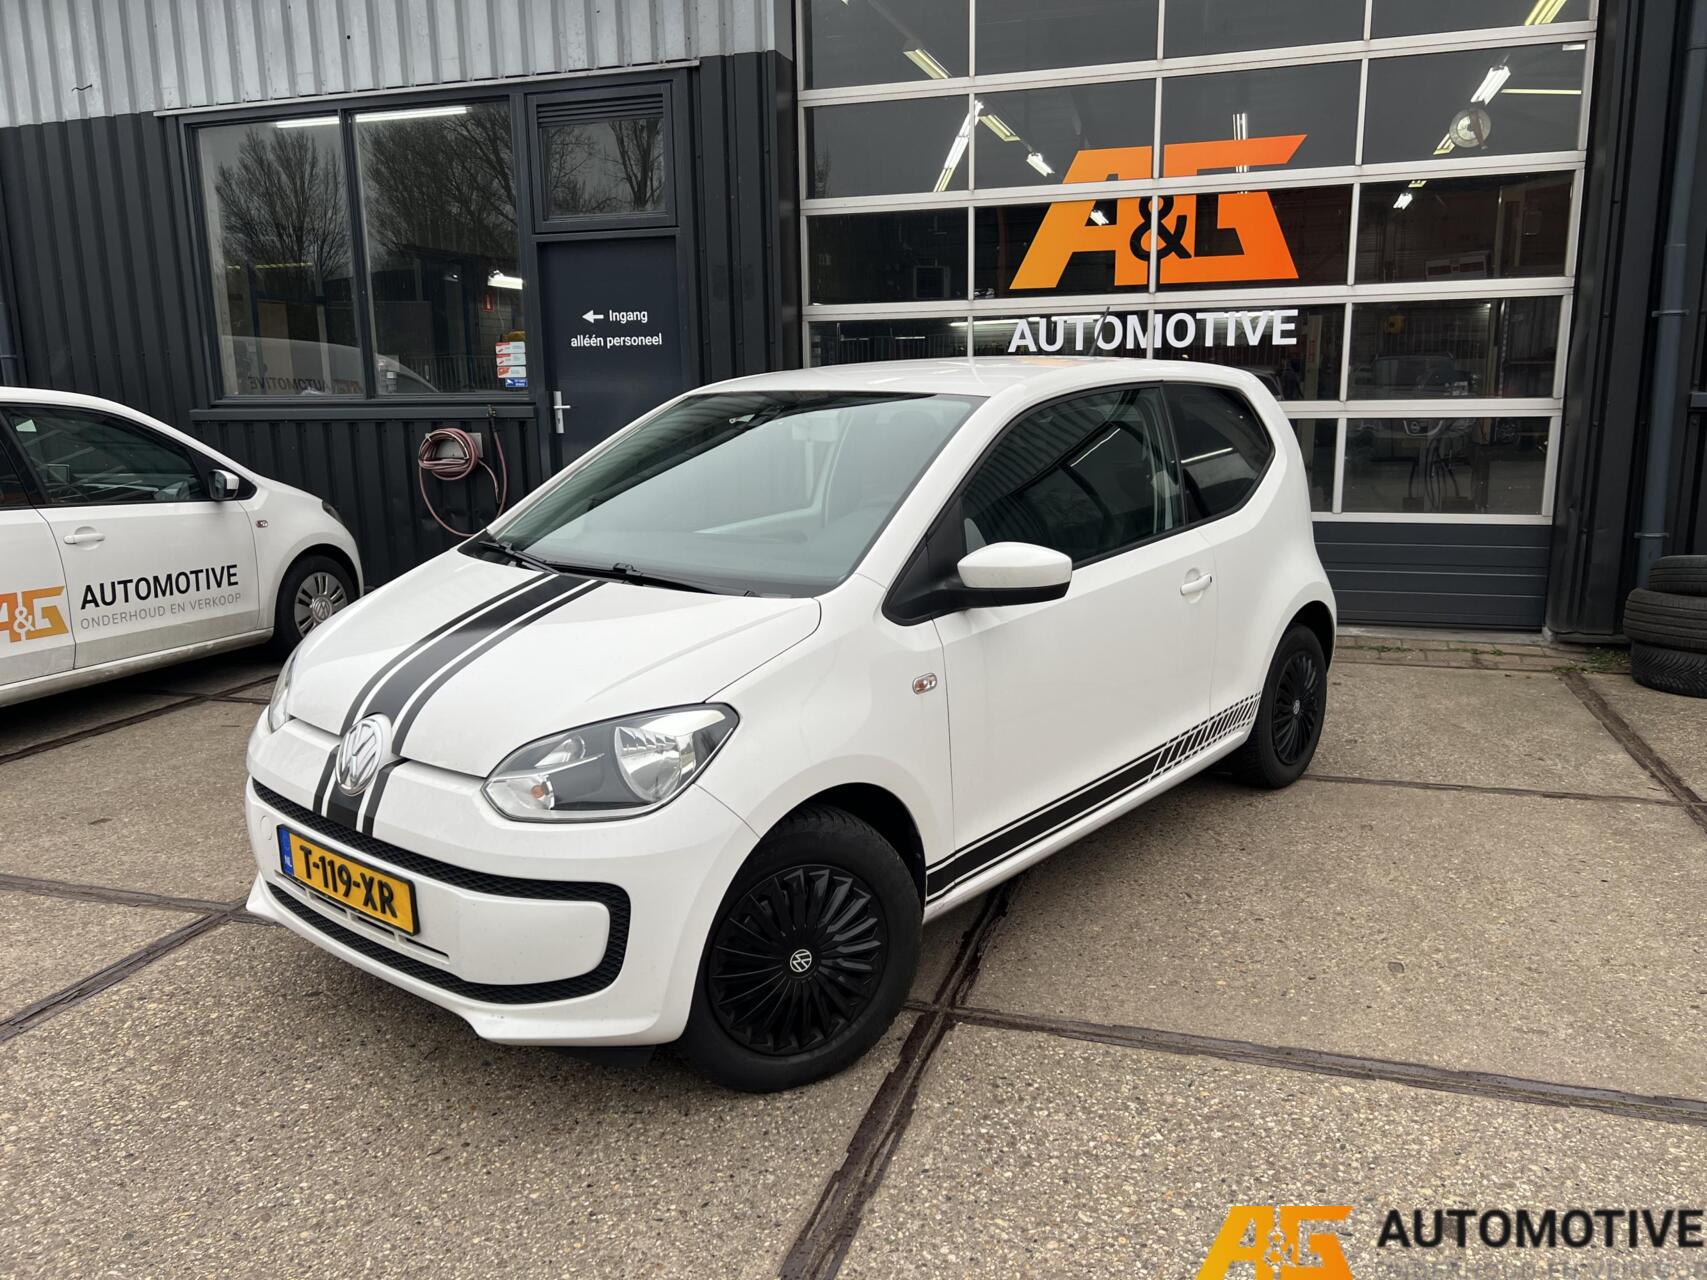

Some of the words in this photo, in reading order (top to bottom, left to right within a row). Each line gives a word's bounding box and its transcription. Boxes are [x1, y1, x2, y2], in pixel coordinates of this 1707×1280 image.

[1009, 134, 1307, 290] A&G
[609, 310, 648, 323] Ingang
[1007, 309, 1299, 353] AUTOMOTIVE
[570, 334, 604, 347] alléén
[606, 333, 662, 349] personeel
[80, 564, 239, 610] AUTOMOTIVE
[80, 605, 166, 630] ONDERHOUD
[171, 602, 186, 615] EN
[190, 593, 242, 611] VERKOOP
[299, 844, 398, 919] T-119-XR
